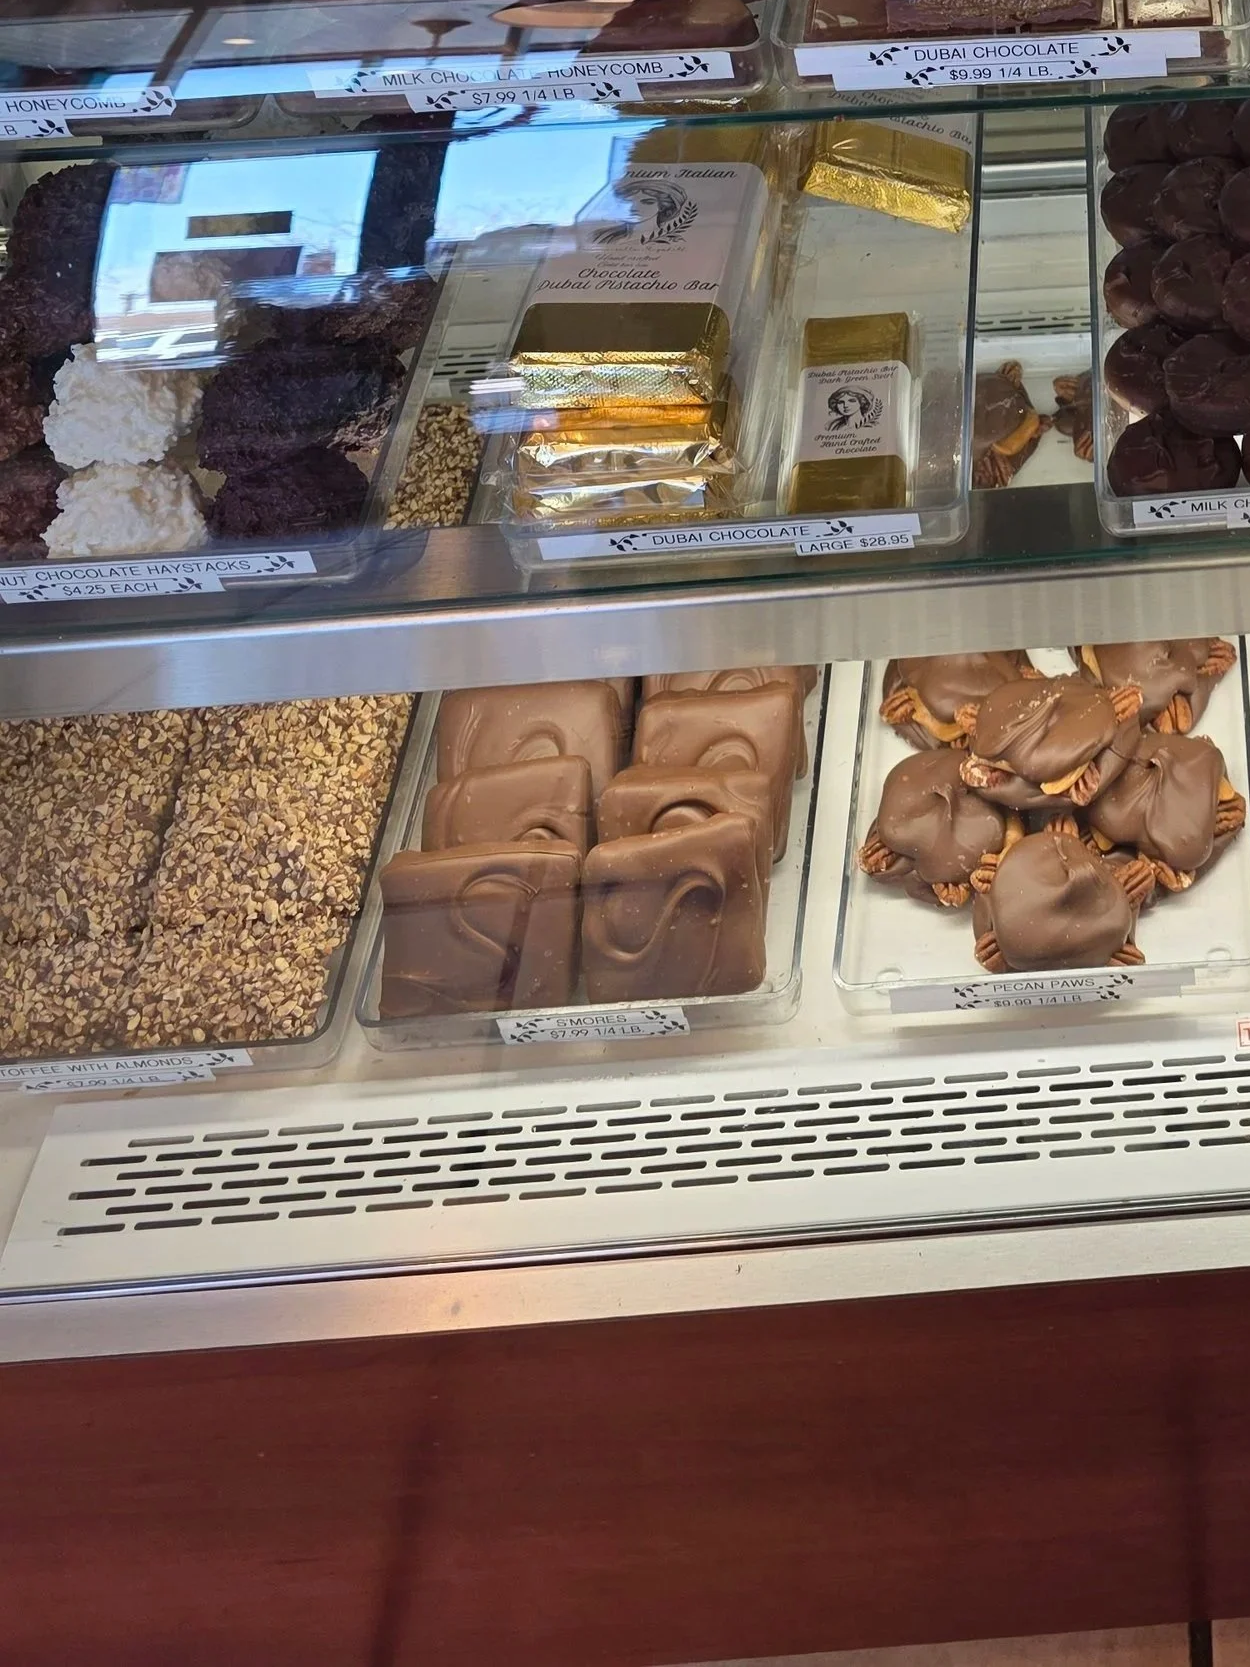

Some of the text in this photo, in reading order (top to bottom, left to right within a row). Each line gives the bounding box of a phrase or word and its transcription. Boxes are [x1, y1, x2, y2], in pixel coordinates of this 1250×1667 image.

[914, 42, 1079, 62] DUBAI CHOCOLATE
[949, 65, 1053, 80] $9.99 1/4 LB.
[472, 87, 576, 105] $7.99 1/4 LB
[578, 267, 662, 279] Chocolate
[536, 278, 591, 291] Dubai
[595, 278, 678, 291] Pistachio
[1191, 500, 1227, 512] MILK
[653, 526, 811, 546] DUBAI CHOCOLATE
[799, 534, 909, 554] LARGE $28.95
[35, 566, 141, 583] CHOCOLATE
[146, 559, 251, 575] HAYSTACKS
[63, 581, 158, 596] $4.25 EACH
[993, 977, 1096, 993] PECAN PAWS
[0, 1056, 193, 1078] TOFFEE WITH ALMONDS
